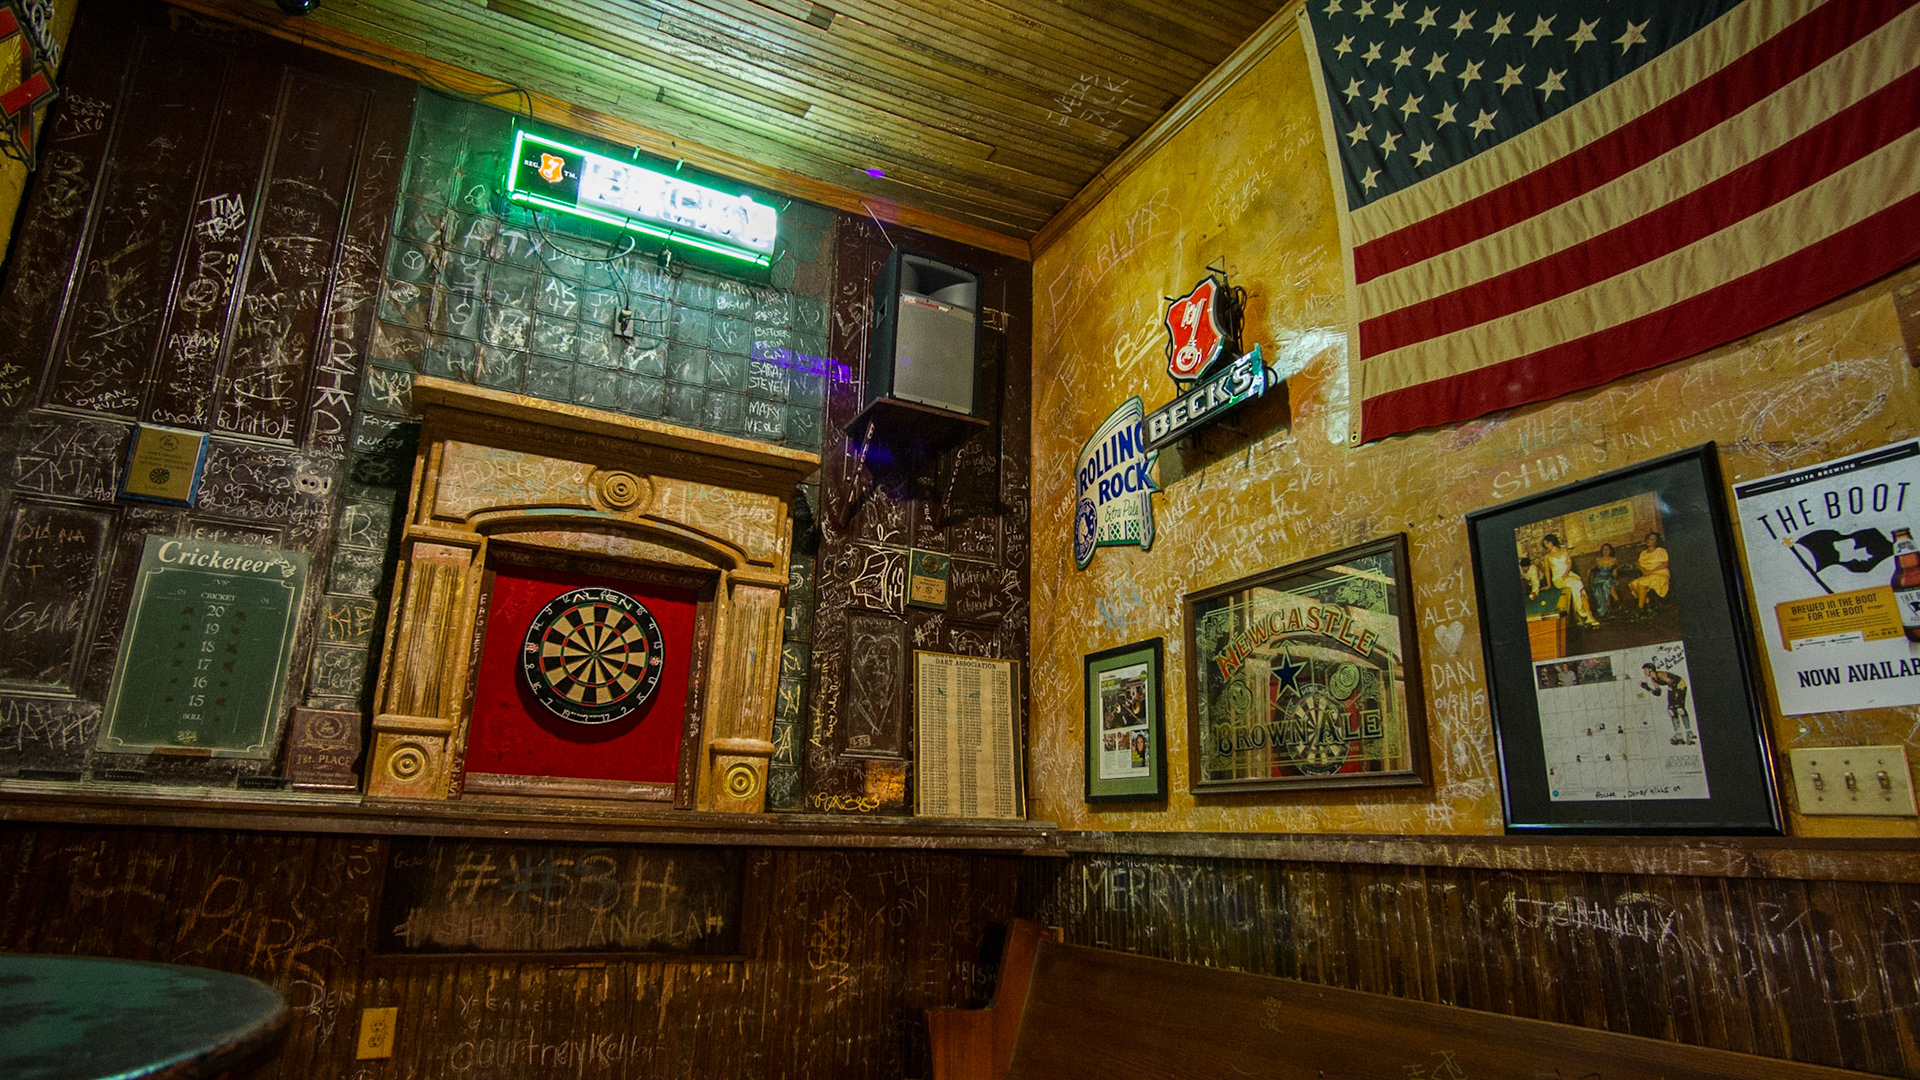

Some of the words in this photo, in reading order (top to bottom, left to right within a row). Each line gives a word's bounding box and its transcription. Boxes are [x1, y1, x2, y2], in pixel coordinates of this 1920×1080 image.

[524, 159, 540, 169] REG.
[1149, 361, 1254, 443] BECK'S
[1789, 473, 1815, 484] ABITA
[1817, 463, 1856, 478] BREWING
[1098, 459, 1154, 507] ROCK
[1757, 498, 1815, 540] THE
[1824, 482, 1911, 519] BOOT
[158, 540, 275, 574] Cricketeer
[200, 592, 237, 601] CRICKET
[573, 592, 632, 610] ALIEN
[1790, 602, 1826, 615] BREWED
[1827, 600, 1836, 609] IN
[1837, 596, 1853, 608] THE
[1855, 593, 1878, 605] BOOT
[206, 605, 225, 617] 20
[1424, 599, 1472, 628] ALEX
[1807, 611, 1824, 621] FOR
[1825, 608, 1841, 619] THE
[1843, 605, 1865, 616] BOOT
[204, 623, 220, 635] 19
[201, 640, 215, 652] 18
[1215, 606, 1379, 684] NEWCASTLE
[197, 659, 212, 671] 17
[935, 658, 953, 666] DART
[956, 661, 996, 669] ASSOCIATION
[193, 677, 208, 688] 16
[1430, 661, 1476, 690] DAN
[1797, 667, 1841, 688] NOW
[188, 695, 204, 707] 15
[1215, 718, 1309, 757] BROWN
[1316, 709, 1384, 746] ALE
[319, 755, 352, 767] PLACE
